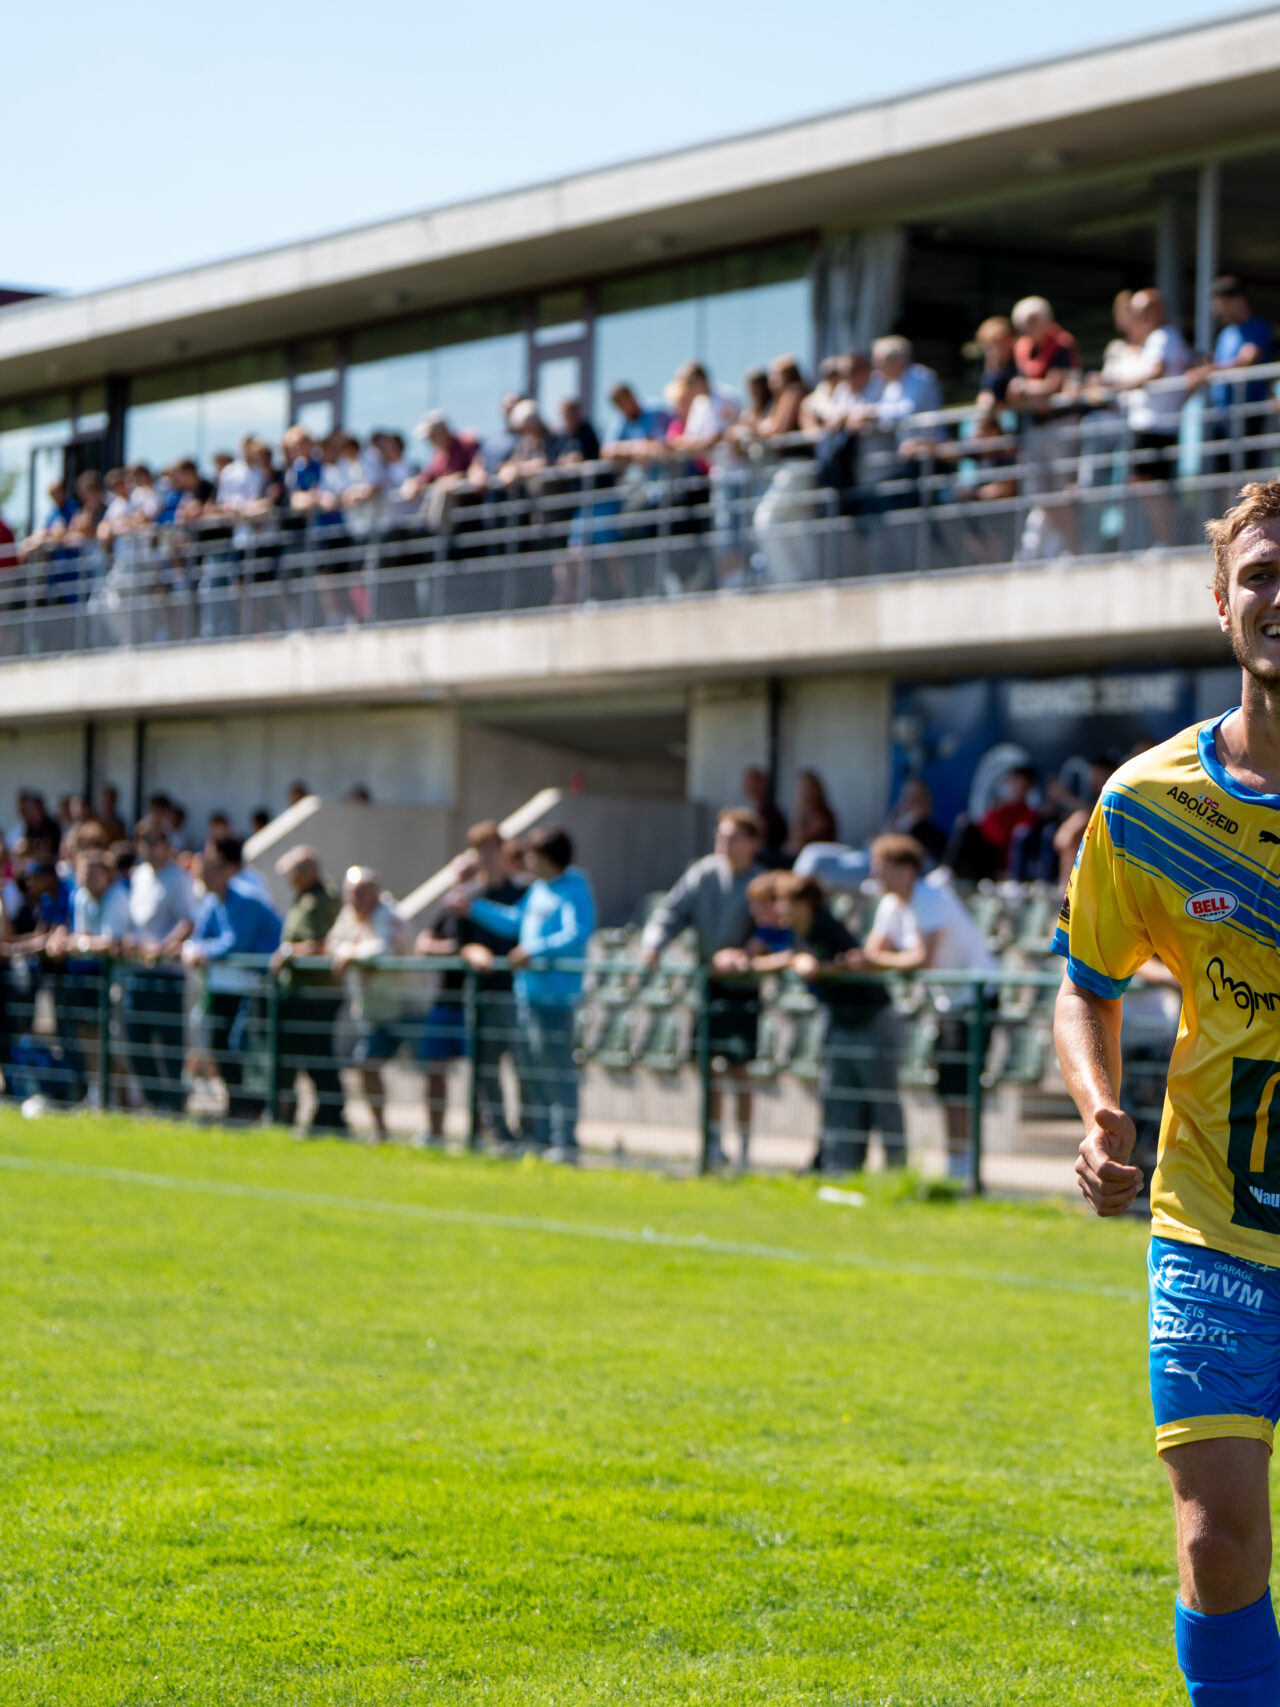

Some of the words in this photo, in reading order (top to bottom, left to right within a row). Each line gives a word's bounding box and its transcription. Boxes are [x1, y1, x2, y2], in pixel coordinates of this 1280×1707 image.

[1191, 897, 1231, 915] BELL
[1214, 1261, 1255, 1282] GARAGE
[1193, 1268, 1264, 1310] MVM
